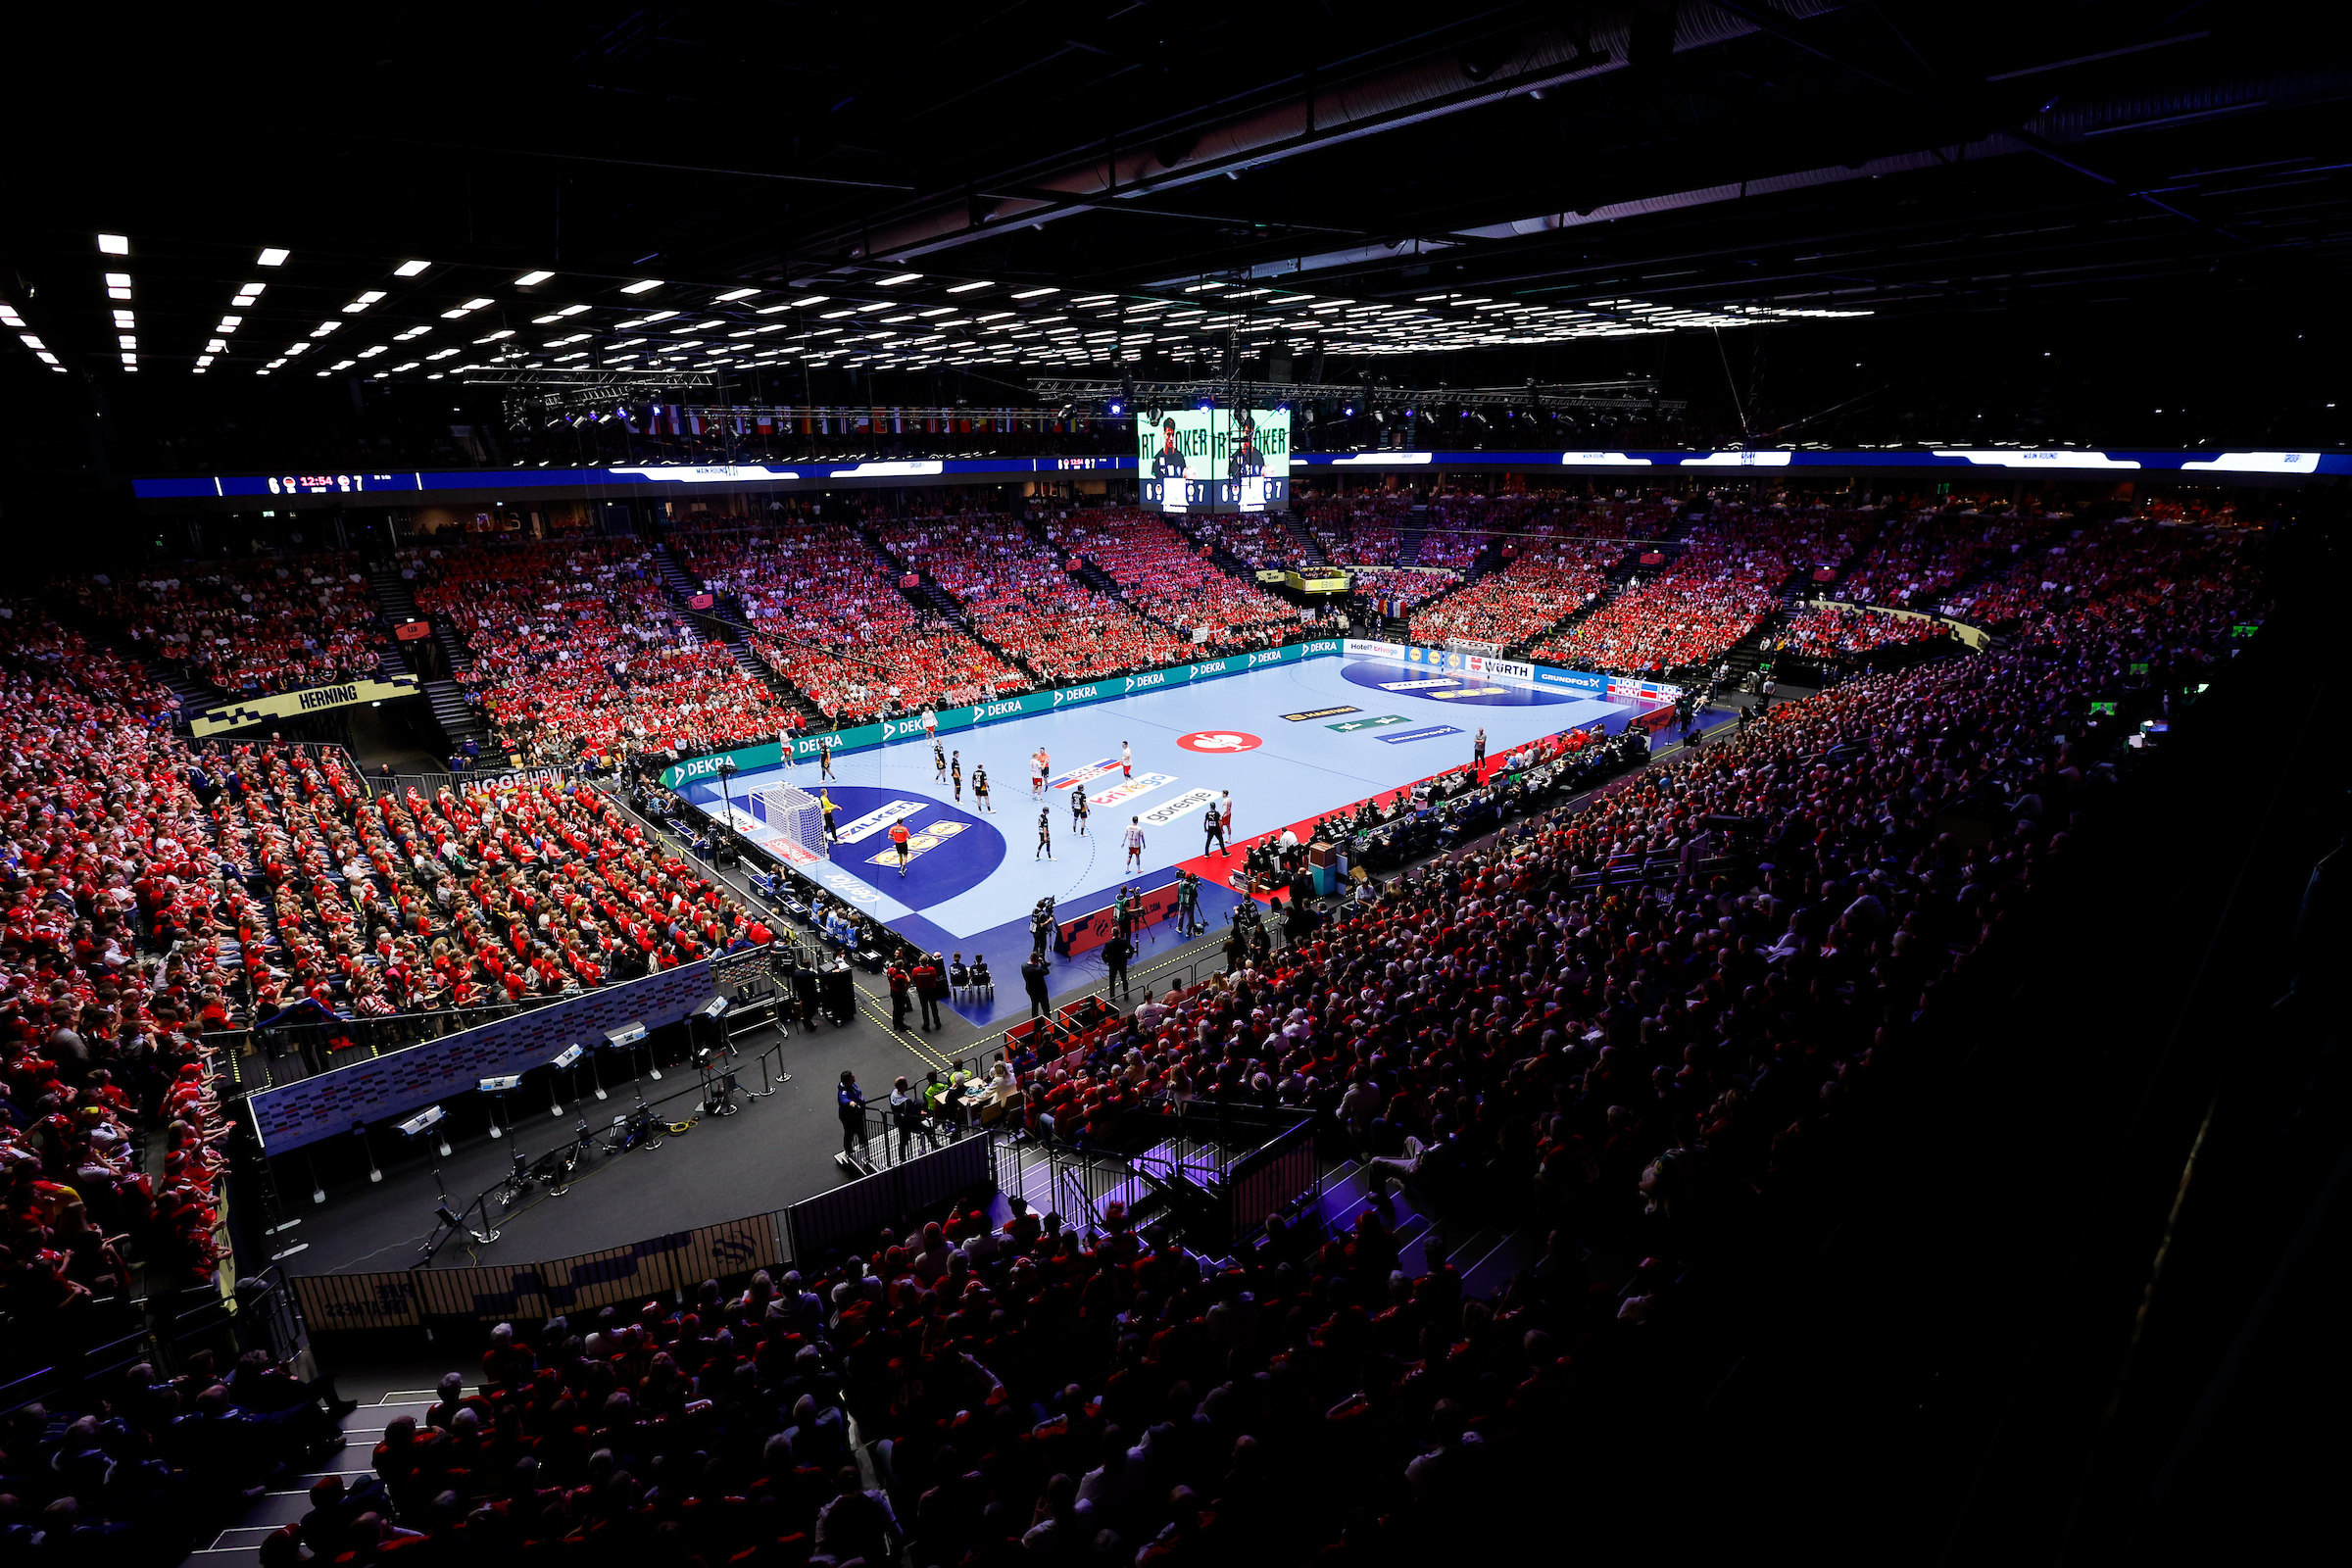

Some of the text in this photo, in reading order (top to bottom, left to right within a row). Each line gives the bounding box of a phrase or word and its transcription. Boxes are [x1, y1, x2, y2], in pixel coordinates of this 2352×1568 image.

[268, 476, 280, 495] 6
[300, 475, 333, 487] 12:54
[353, 474, 363, 492] 7
[1198, 484, 1204, 502] 7
[1276, 481, 1282, 499] 7
[1310, 641, 1338, 654] DEKRA
[1350, 643, 1398, 656] Hotel? trivago
[1257, 650, 1282, 663] DEKRA
[1200, 661, 1226, 674] DEKRA
[1137, 672, 1165, 688] DEKRA
[1541, 673, 1590, 687] GRUNDFOS
[1617, 679, 1640, 691] LIQUI
[298, 685, 358, 710] HERNING
[1066, 685, 1098, 702] DEKRA
[1617, 687, 1641, 698] MOLY
[988, 700, 1022, 717] DEKRA
[899, 717, 925, 734] DEK
[1090, 774, 1166, 805] trivago
[1147, 791, 1211, 822] gorenje
[836, 802, 913, 840] FALKEN
[824, 873, 881, 903] Gerflor
